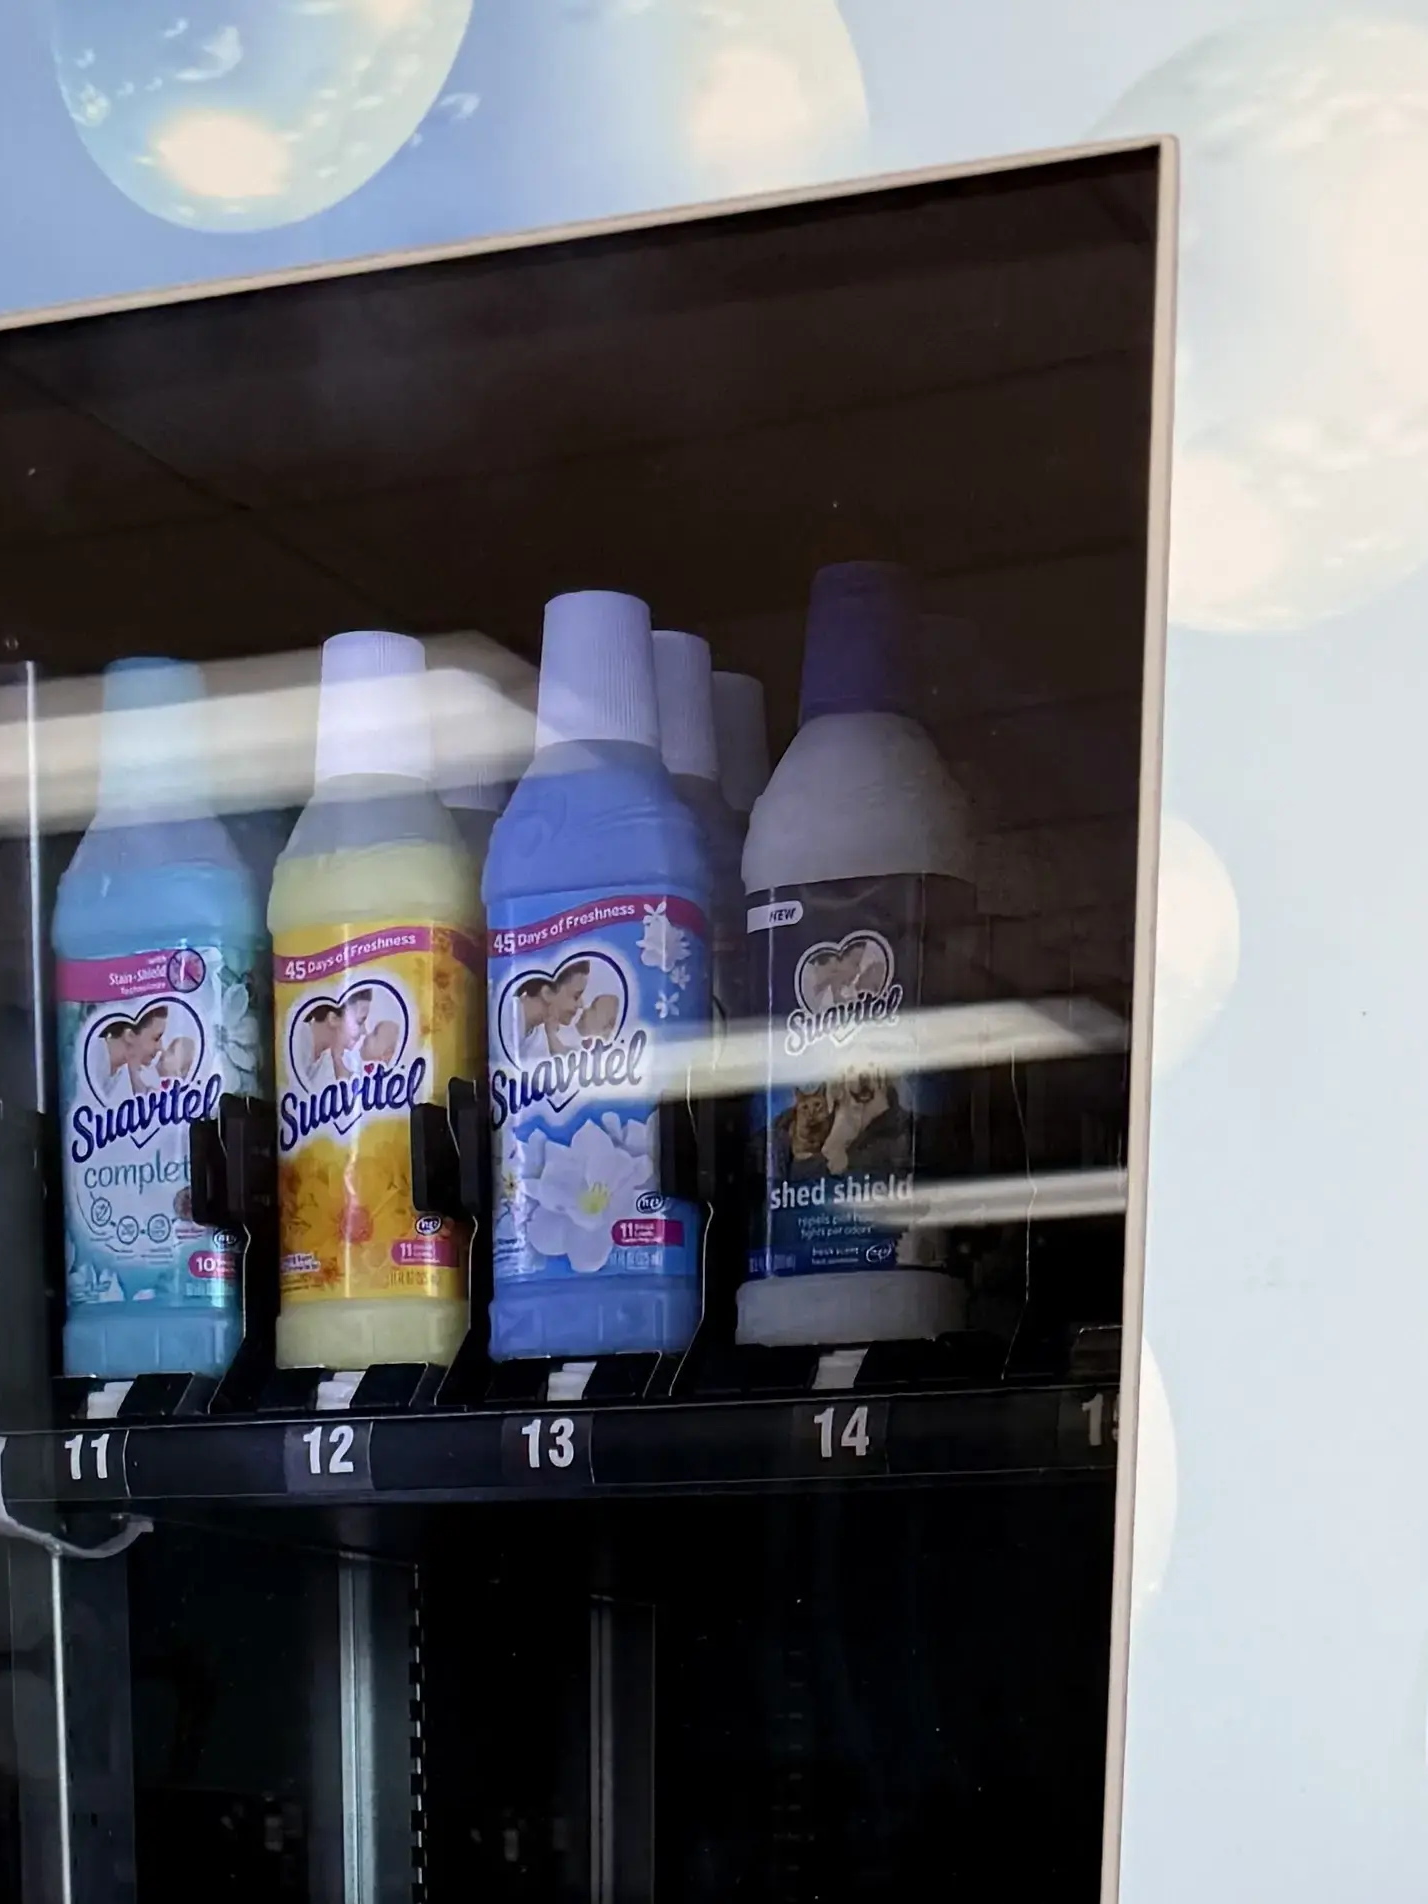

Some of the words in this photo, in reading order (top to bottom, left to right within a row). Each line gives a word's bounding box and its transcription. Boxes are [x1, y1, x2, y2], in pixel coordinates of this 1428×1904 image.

[493, 931, 515, 954] 45
[517, 920, 548, 948] Days
[549, 916, 564, 936] of
[565, 901, 636, 935] Freshness
[769, 907, 798, 923] NEW
[284, 959, 307, 980] 45
[308, 957, 333, 976] Days
[349, 932, 417, 959] Freshness
[84, 1150, 191, 1195] complet
[771, 1177, 825, 1210] shed
[833, 1173, 914, 1204] shield
[195, 1256, 214, 1273] 10
[400, 1243, 413, 1258] 11
[303, 1426, 354, 1474] 12
[521, 1418, 576, 1469] 13
[813, 1406, 870, 1458] 14
[64, 1434, 110, 1480] 11
